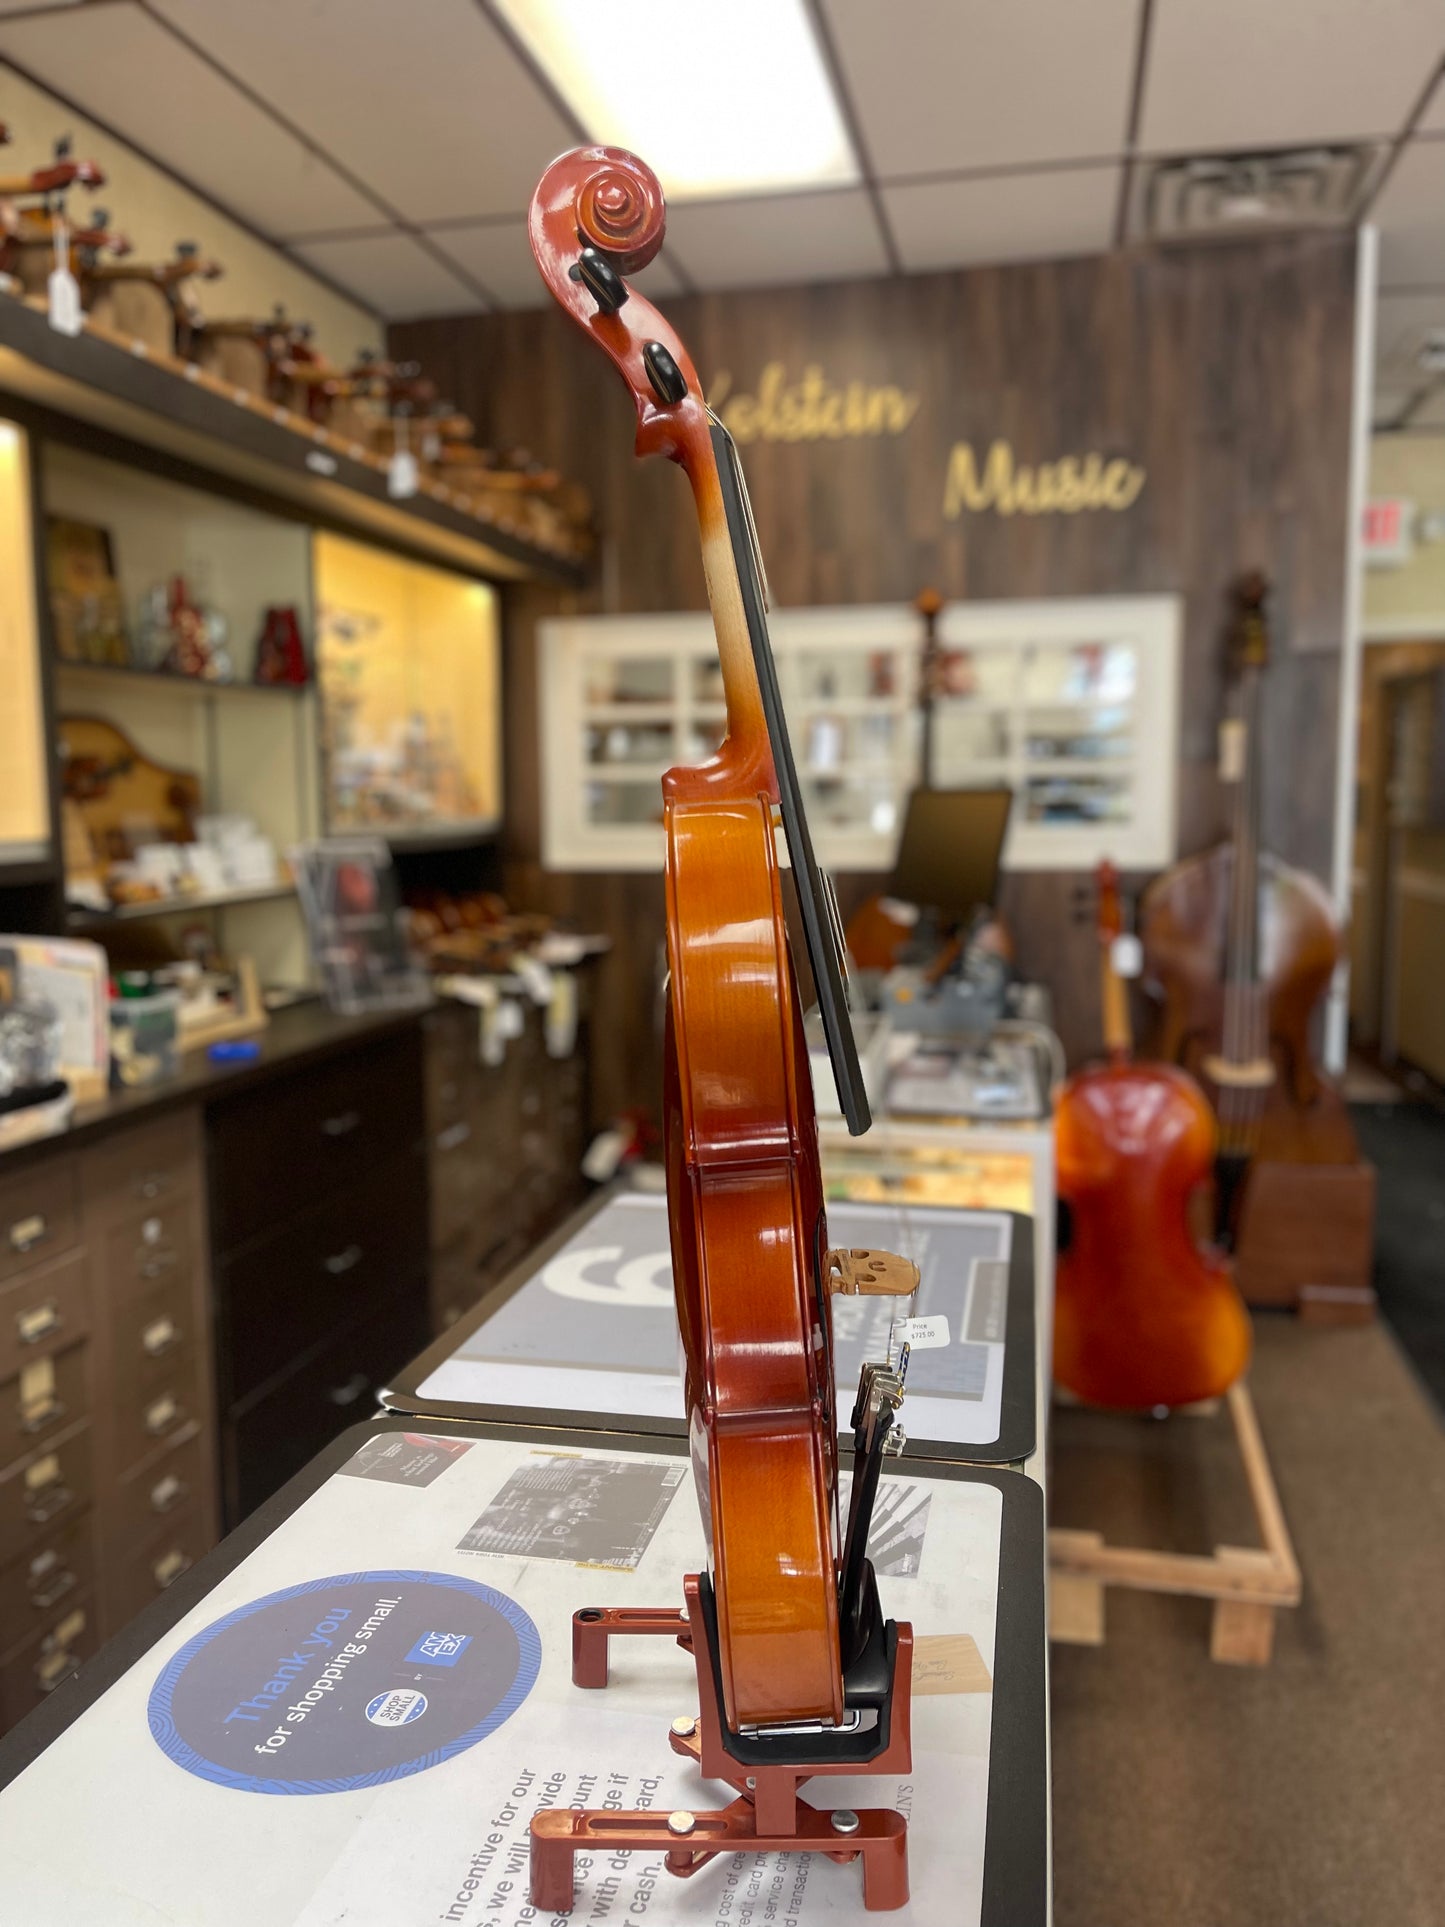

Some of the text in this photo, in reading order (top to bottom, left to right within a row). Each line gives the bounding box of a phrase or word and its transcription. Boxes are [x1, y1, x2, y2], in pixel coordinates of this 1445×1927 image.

[943, 439, 1147, 520] Music
[911, 1331, 936, 1339] $725.00
[223, 1607, 353, 1725] Thank you
[254, 1596, 403, 1755] for shopping small.
[380, 1695, 402, 1719] SHOP
[389, 1695, 416, 1722] SMALL
[607, 1772, 630, 1785] if
[439, 1832, 504, 1922] incentive
[490, 1801, 519, 1828] for
[511, 1768, 537, 1798] our
[486, 1880, 514, 1909] we
[504, 1842, 531, 1875] will
[590, 1876, 622, 1919] with
[629, 1861, 662, 1915] cash.
[726, 1872, 740, 1886] of
[747, 1870, 763, 1898] card
[786, 1851, 812, 1915] transactio
[718, 1889, 736, 1917] cost
[764, 1875, 785, 1921] service
